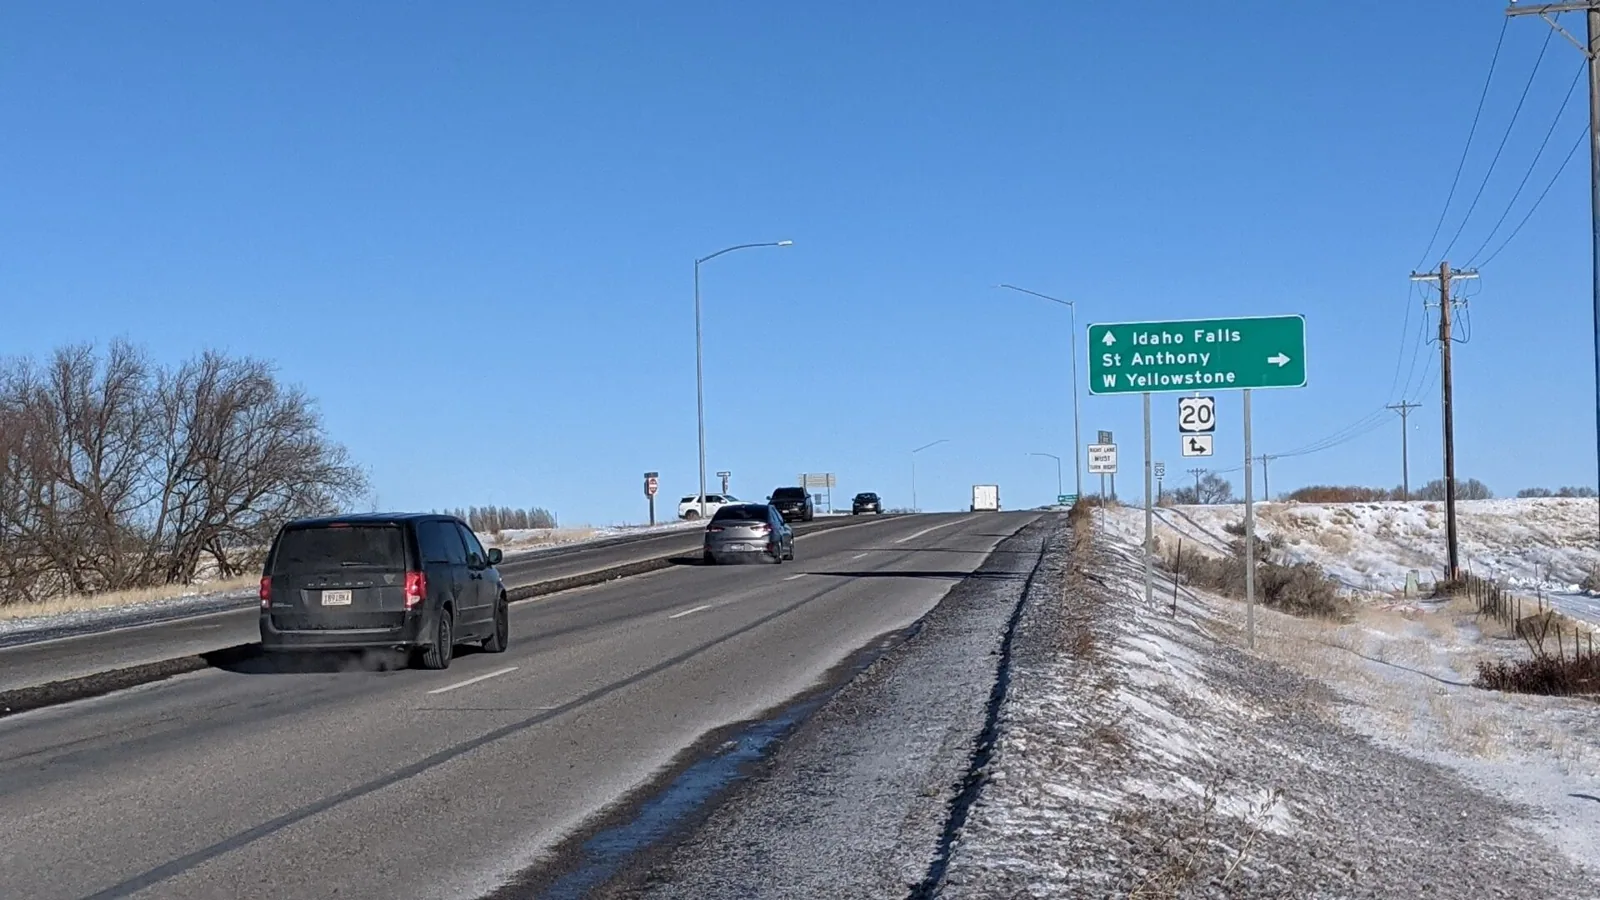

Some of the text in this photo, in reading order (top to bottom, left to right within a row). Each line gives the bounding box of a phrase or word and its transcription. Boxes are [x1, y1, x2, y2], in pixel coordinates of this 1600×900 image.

[1132, 328, 1241, 345] Idaho Falls
[1102, 351, 1210, 367] St Anthony
[1103, 370, 1235, 388] W Yellowstone
[1182, 404, 1212, 424] 20
